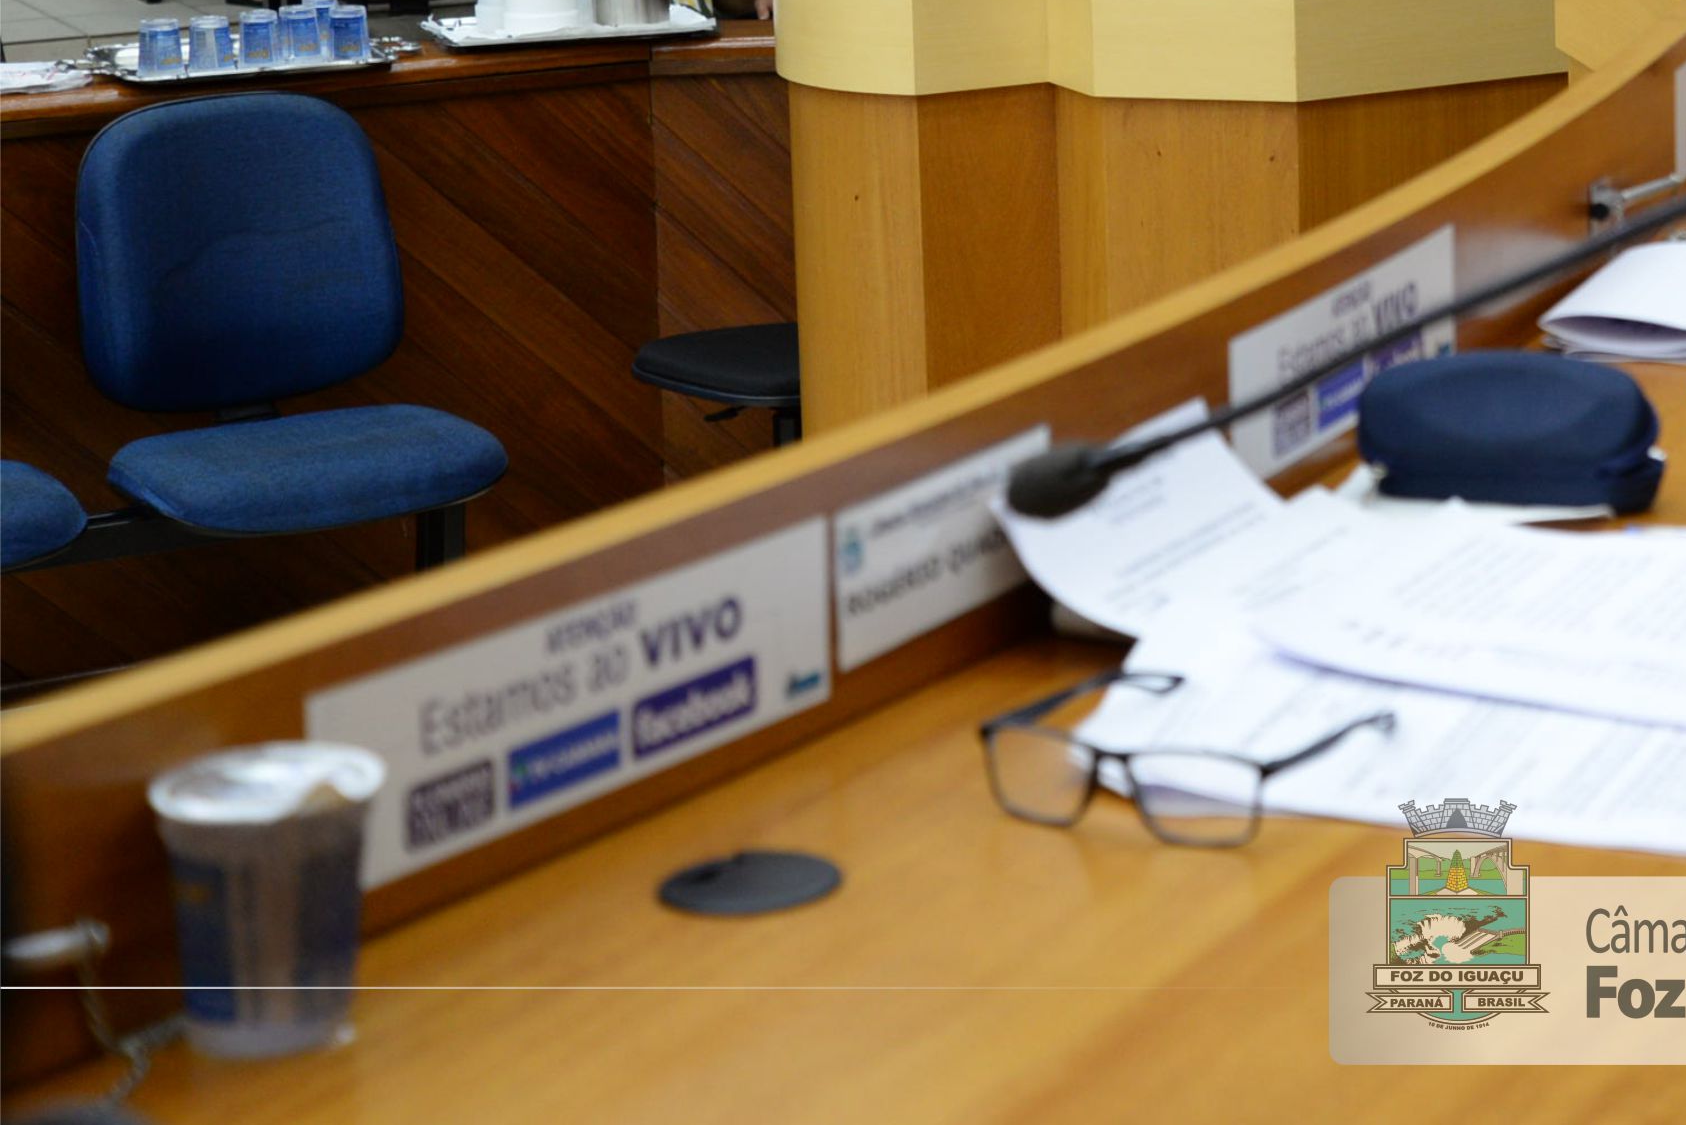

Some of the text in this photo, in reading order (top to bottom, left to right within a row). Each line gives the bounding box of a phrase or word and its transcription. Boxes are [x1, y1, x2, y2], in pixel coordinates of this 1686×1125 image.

[419, 596, 744, 756] Estamos ao VIVO
